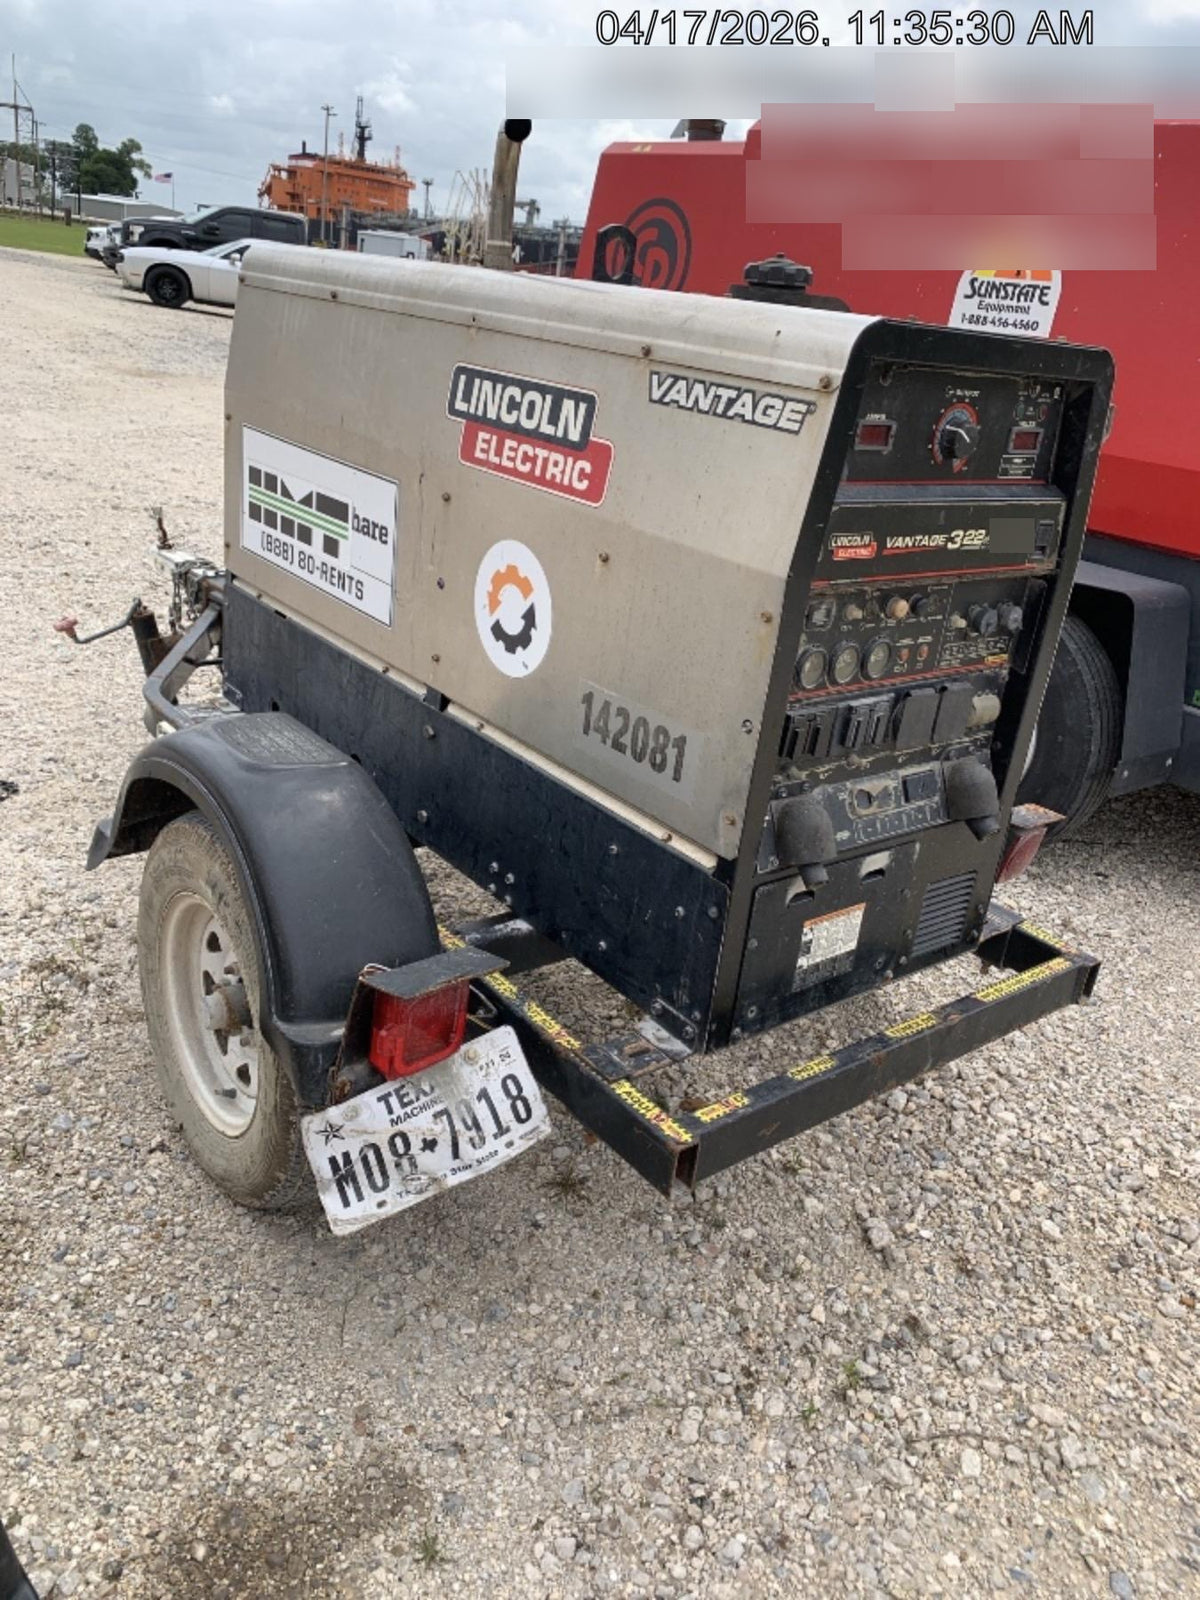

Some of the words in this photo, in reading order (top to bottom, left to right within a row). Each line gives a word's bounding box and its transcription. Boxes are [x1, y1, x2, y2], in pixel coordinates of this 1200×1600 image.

[964, 277, 1051, 306] SUNSTATE
[977, 300, 1031, 315] Equipment
[453, 373, 588, 442] LINCOLN
[650, 374, 809, 431] VANTAGE
[474, 431, 592, 491] ELECTRIC
[260, 530, 295, 565] (888)
[298, 550, 364, 601] 80-RENTS
[886, 534, 948, 549] VANTAGE
[581, 690, 688, 784] 142081
[432, 1072, 533, 1161] 7918
